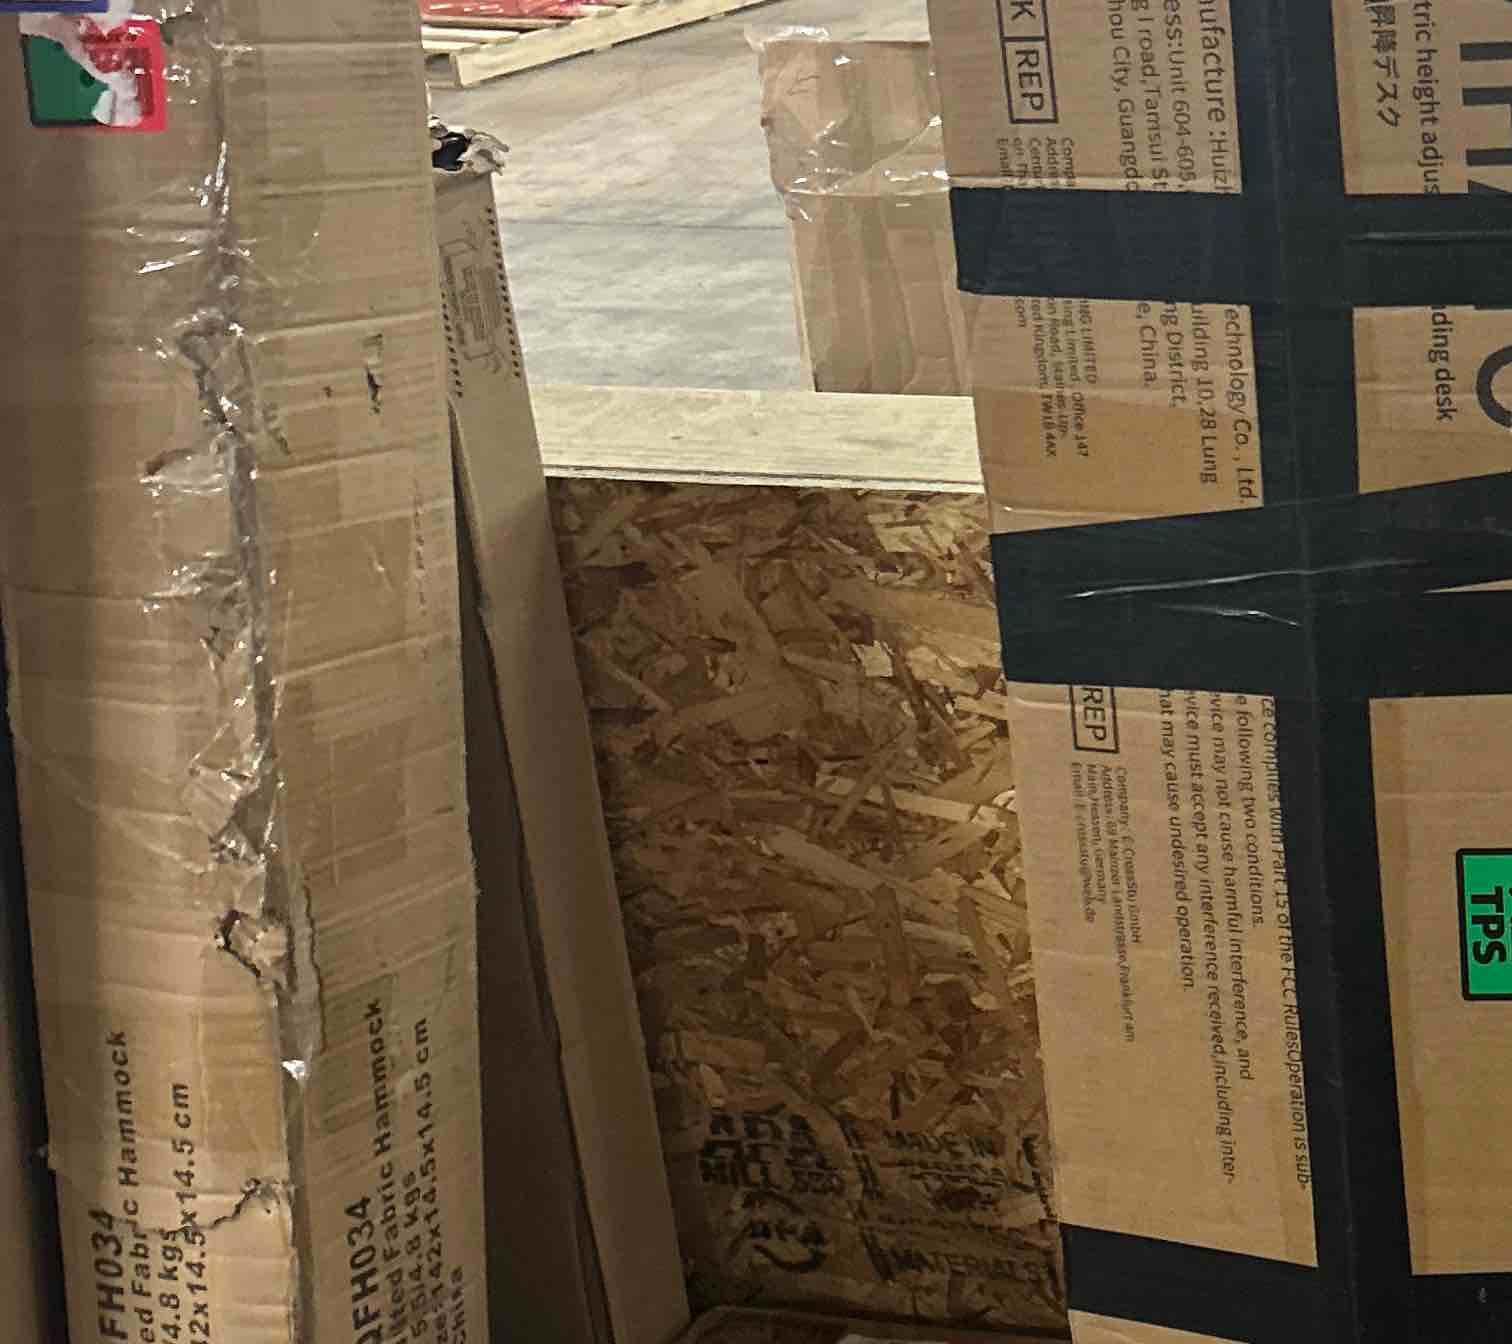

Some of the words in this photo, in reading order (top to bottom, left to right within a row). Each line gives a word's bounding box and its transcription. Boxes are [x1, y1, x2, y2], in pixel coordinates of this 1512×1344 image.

[1015, 48, 1044, 112] REP
[1112, 45, 1132, 93] City,
[1411, 48, 1439, 125] height
[1434, 367, 1458, 422] desk
[1223, 308, 1250, 414] echnology
[1199, 435, 1219, 485] Lung
[1081, 686, 1108, 742] REP
[1159, 720, 1178, 757] may
[1186, 734, 1203, 779] must
[1210, 736, 1229, 775] may
[1234, 709, 1256, 793] following
[1163, 761, 1182, 812] cause
[1187, 781, 1208, 840] accept
[1216, 778, 1232, 808] not
[1217, 811, 1235, 864] cause
[1242, 796, 1259, 830] two
[1169, 815, 1193, 901] undesired
[1191, 843, 1211, 874] any
[1222, 866, 1243, 933] harmful
[1277, 912, 1294, 931] of
[1470, 884, 1508, 966] TPS
[1199, 878, 1221, 981] interference
[1278, 934, 1295, 963] the
[1280, 966, 1298, 999] FCC
[412, 1017, 430, 1065] cm
[1237, 1047, 1255, 1081] and
[362, 997, 393, 1157] Hammock
[103, 1030, 140, 1187] Hammock
[171, 1082, 193, 1129] cm
[1292, 1135, 1307, 1150] is
[376, 1159, 401, 1262] Fabric
[401, 1170, 422, 1229] kgs
